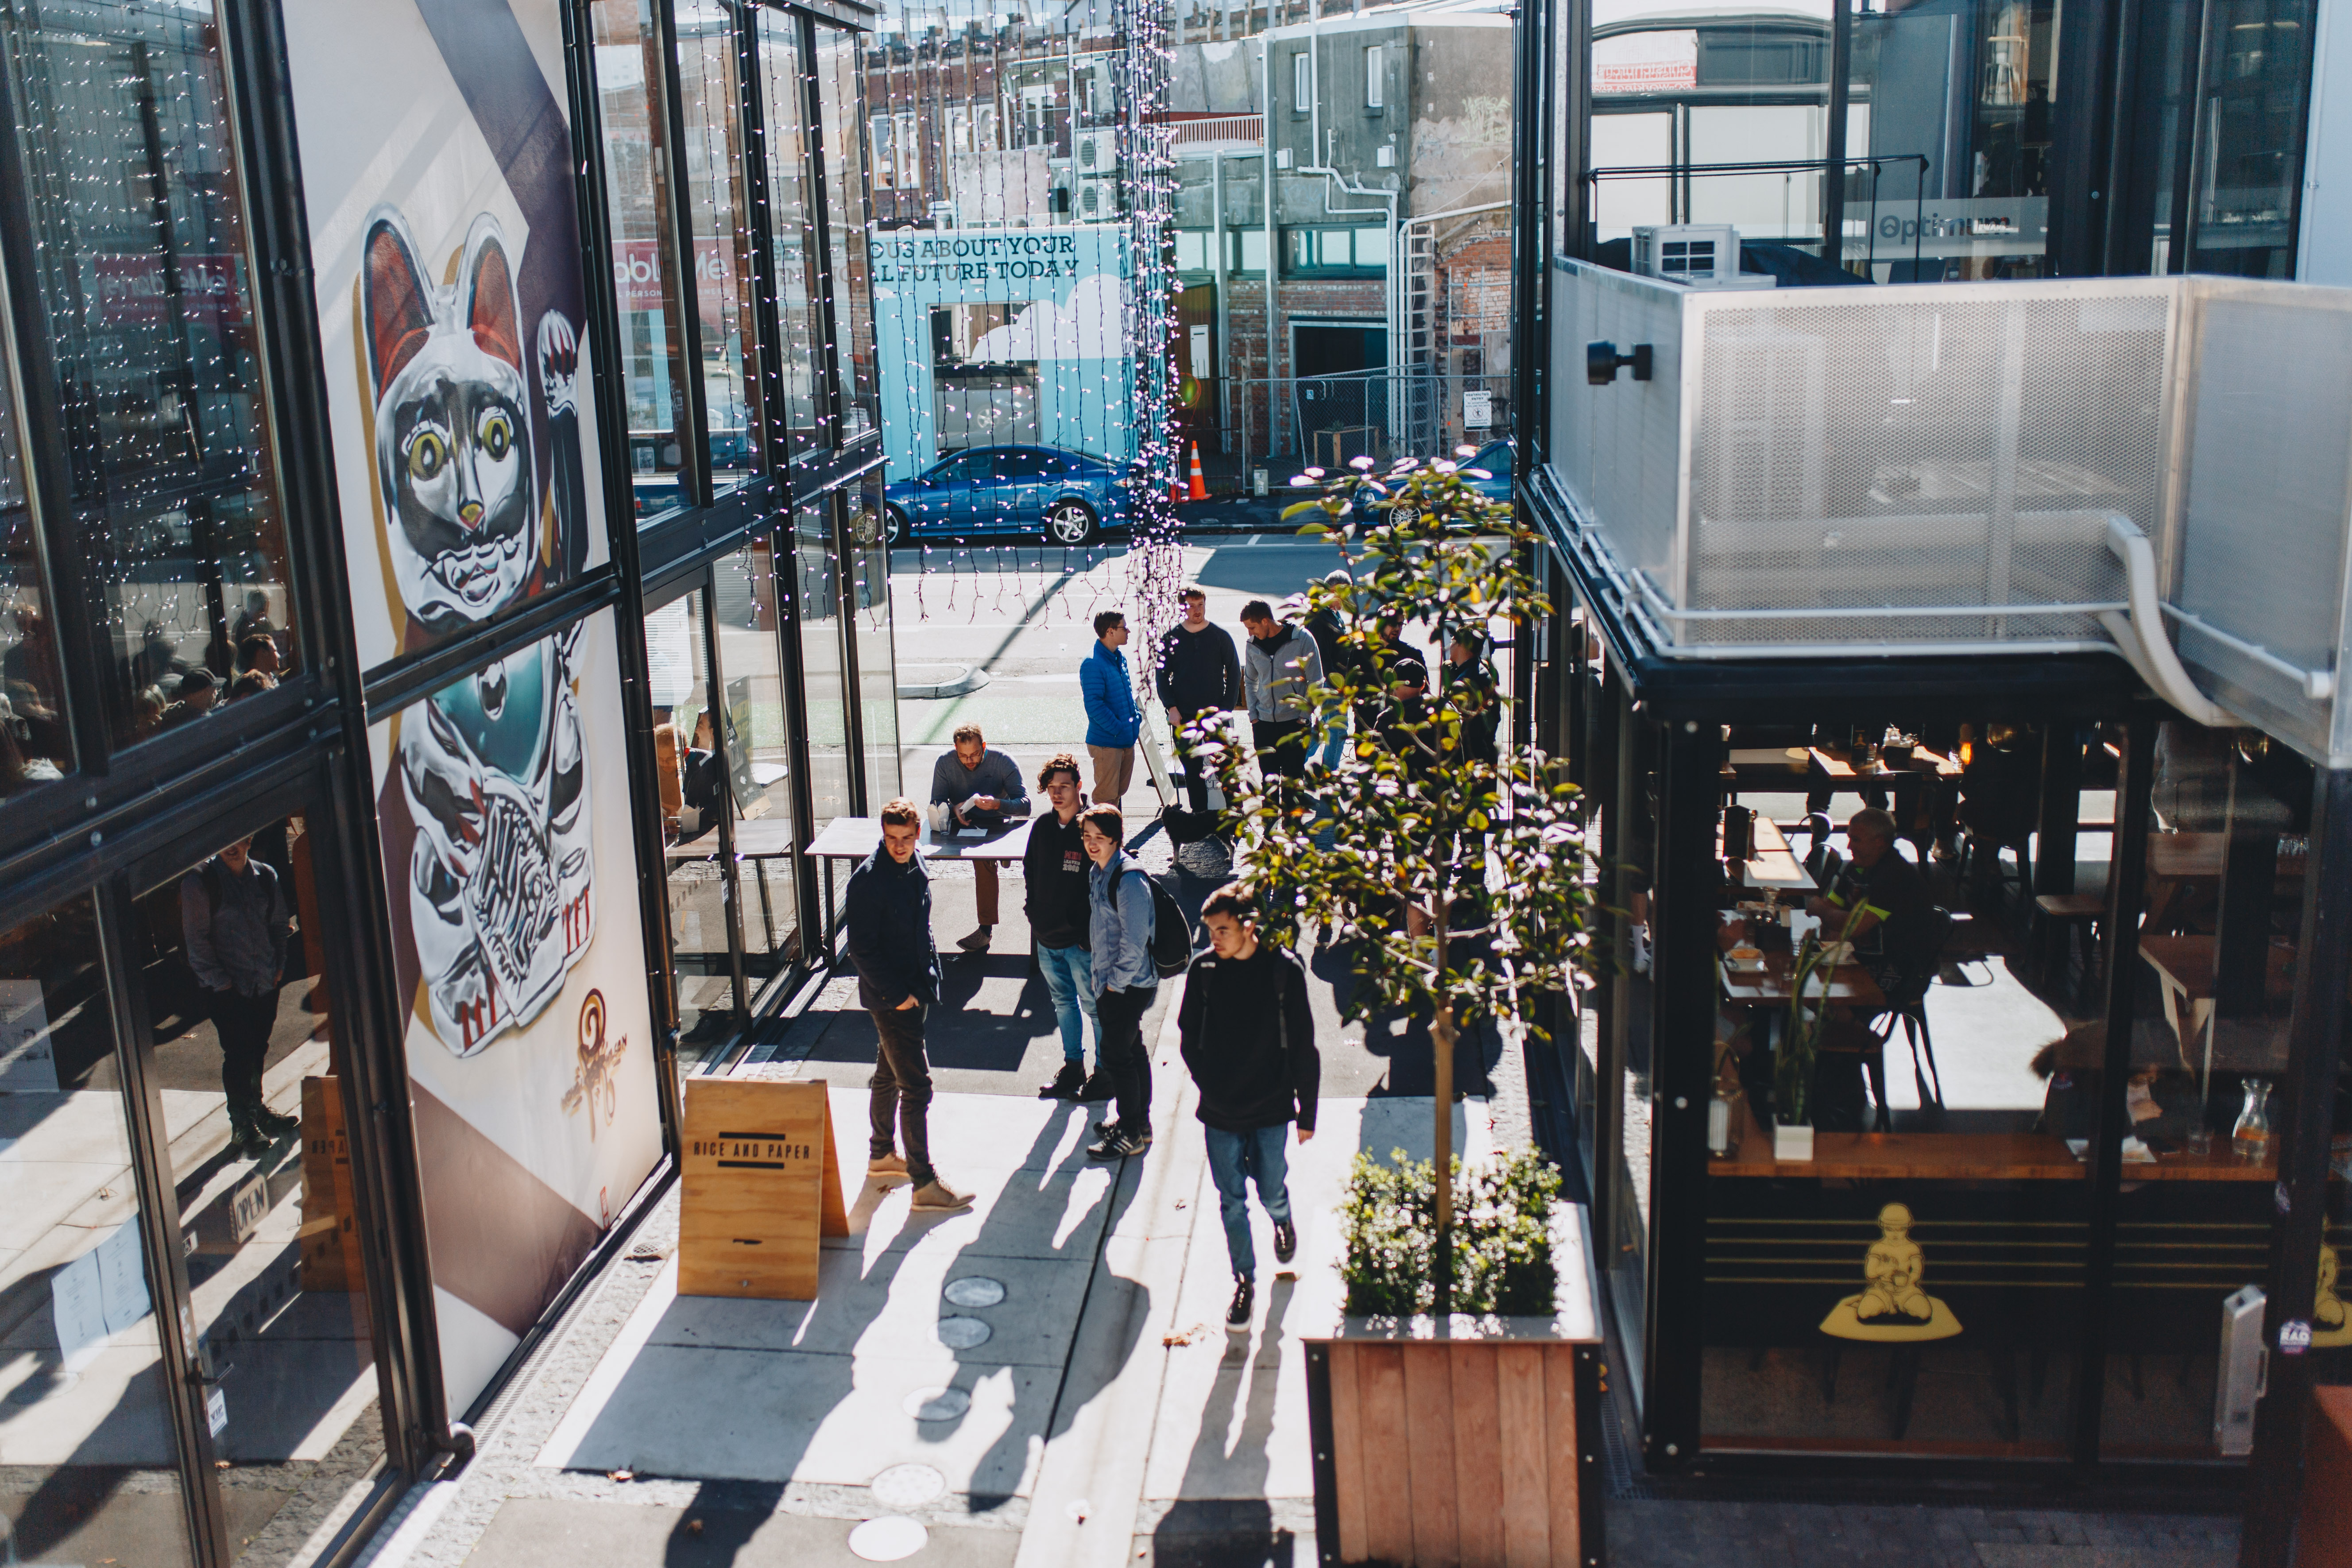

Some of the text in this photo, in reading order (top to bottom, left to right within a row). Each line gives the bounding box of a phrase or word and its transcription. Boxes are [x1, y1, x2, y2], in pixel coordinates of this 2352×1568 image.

[1879, 213, 2011, 245] Optimum
[921, 238, 1001, 258] ABOUT
[1007, 236, 1074, 255] YOUR
[900, 262, 989, 282] FUTURE
[995, 259, 1079, 279] TODAY
[626, 289, 662, 298] PERSON
[694, 1142, 810, 1159] RICE AND PAPER
[236, 1182, 265, 1232] OPEN
[210, 1404, 223, 1421] VIP
